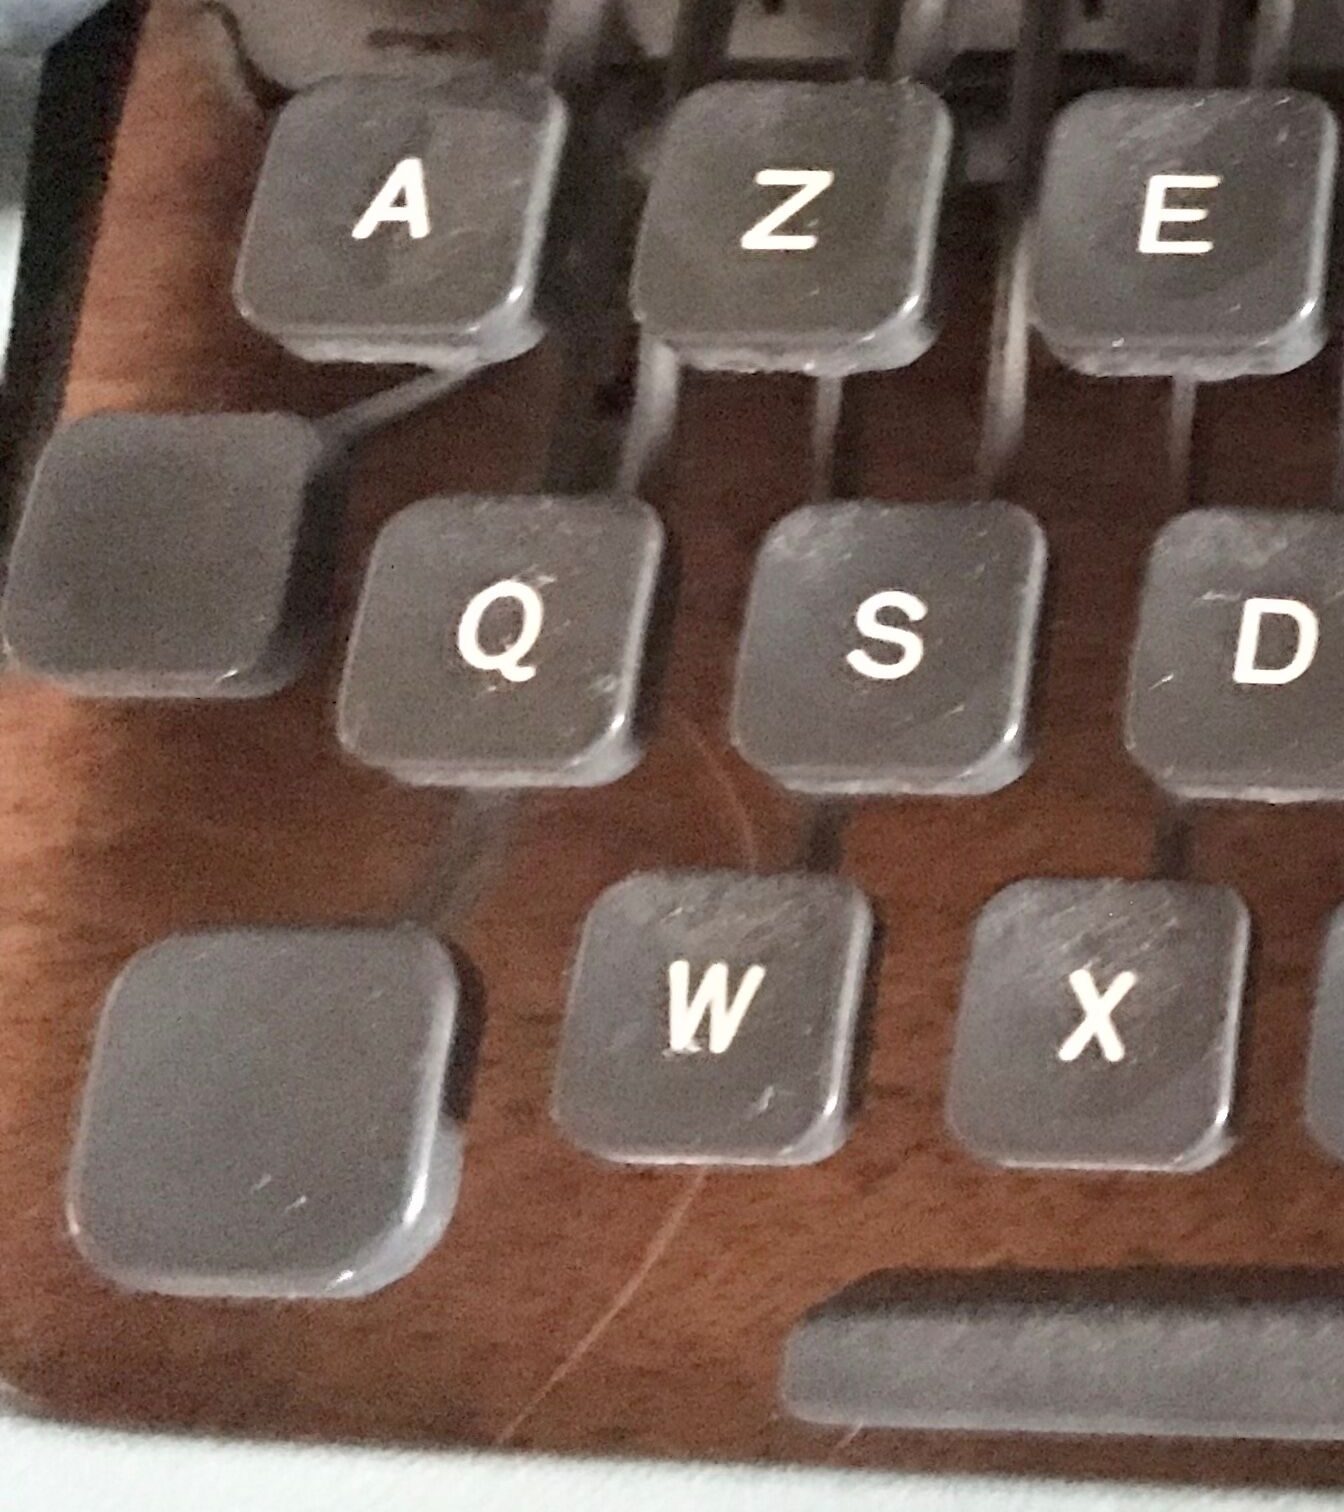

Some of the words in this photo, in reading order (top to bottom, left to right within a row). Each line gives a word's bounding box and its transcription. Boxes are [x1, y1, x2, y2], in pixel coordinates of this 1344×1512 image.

[350, 156, 431, 241] A
[739, 167, 834, 251] Z
[1137, 173, 1222, 255] E
[456, 577, 544, 683] Q
[845, 589, 928, 681] S
[1231, 596, 1320, 686] D
[667, 959, 766, 1055] W
[1057, 961, 1138, 1063] X
